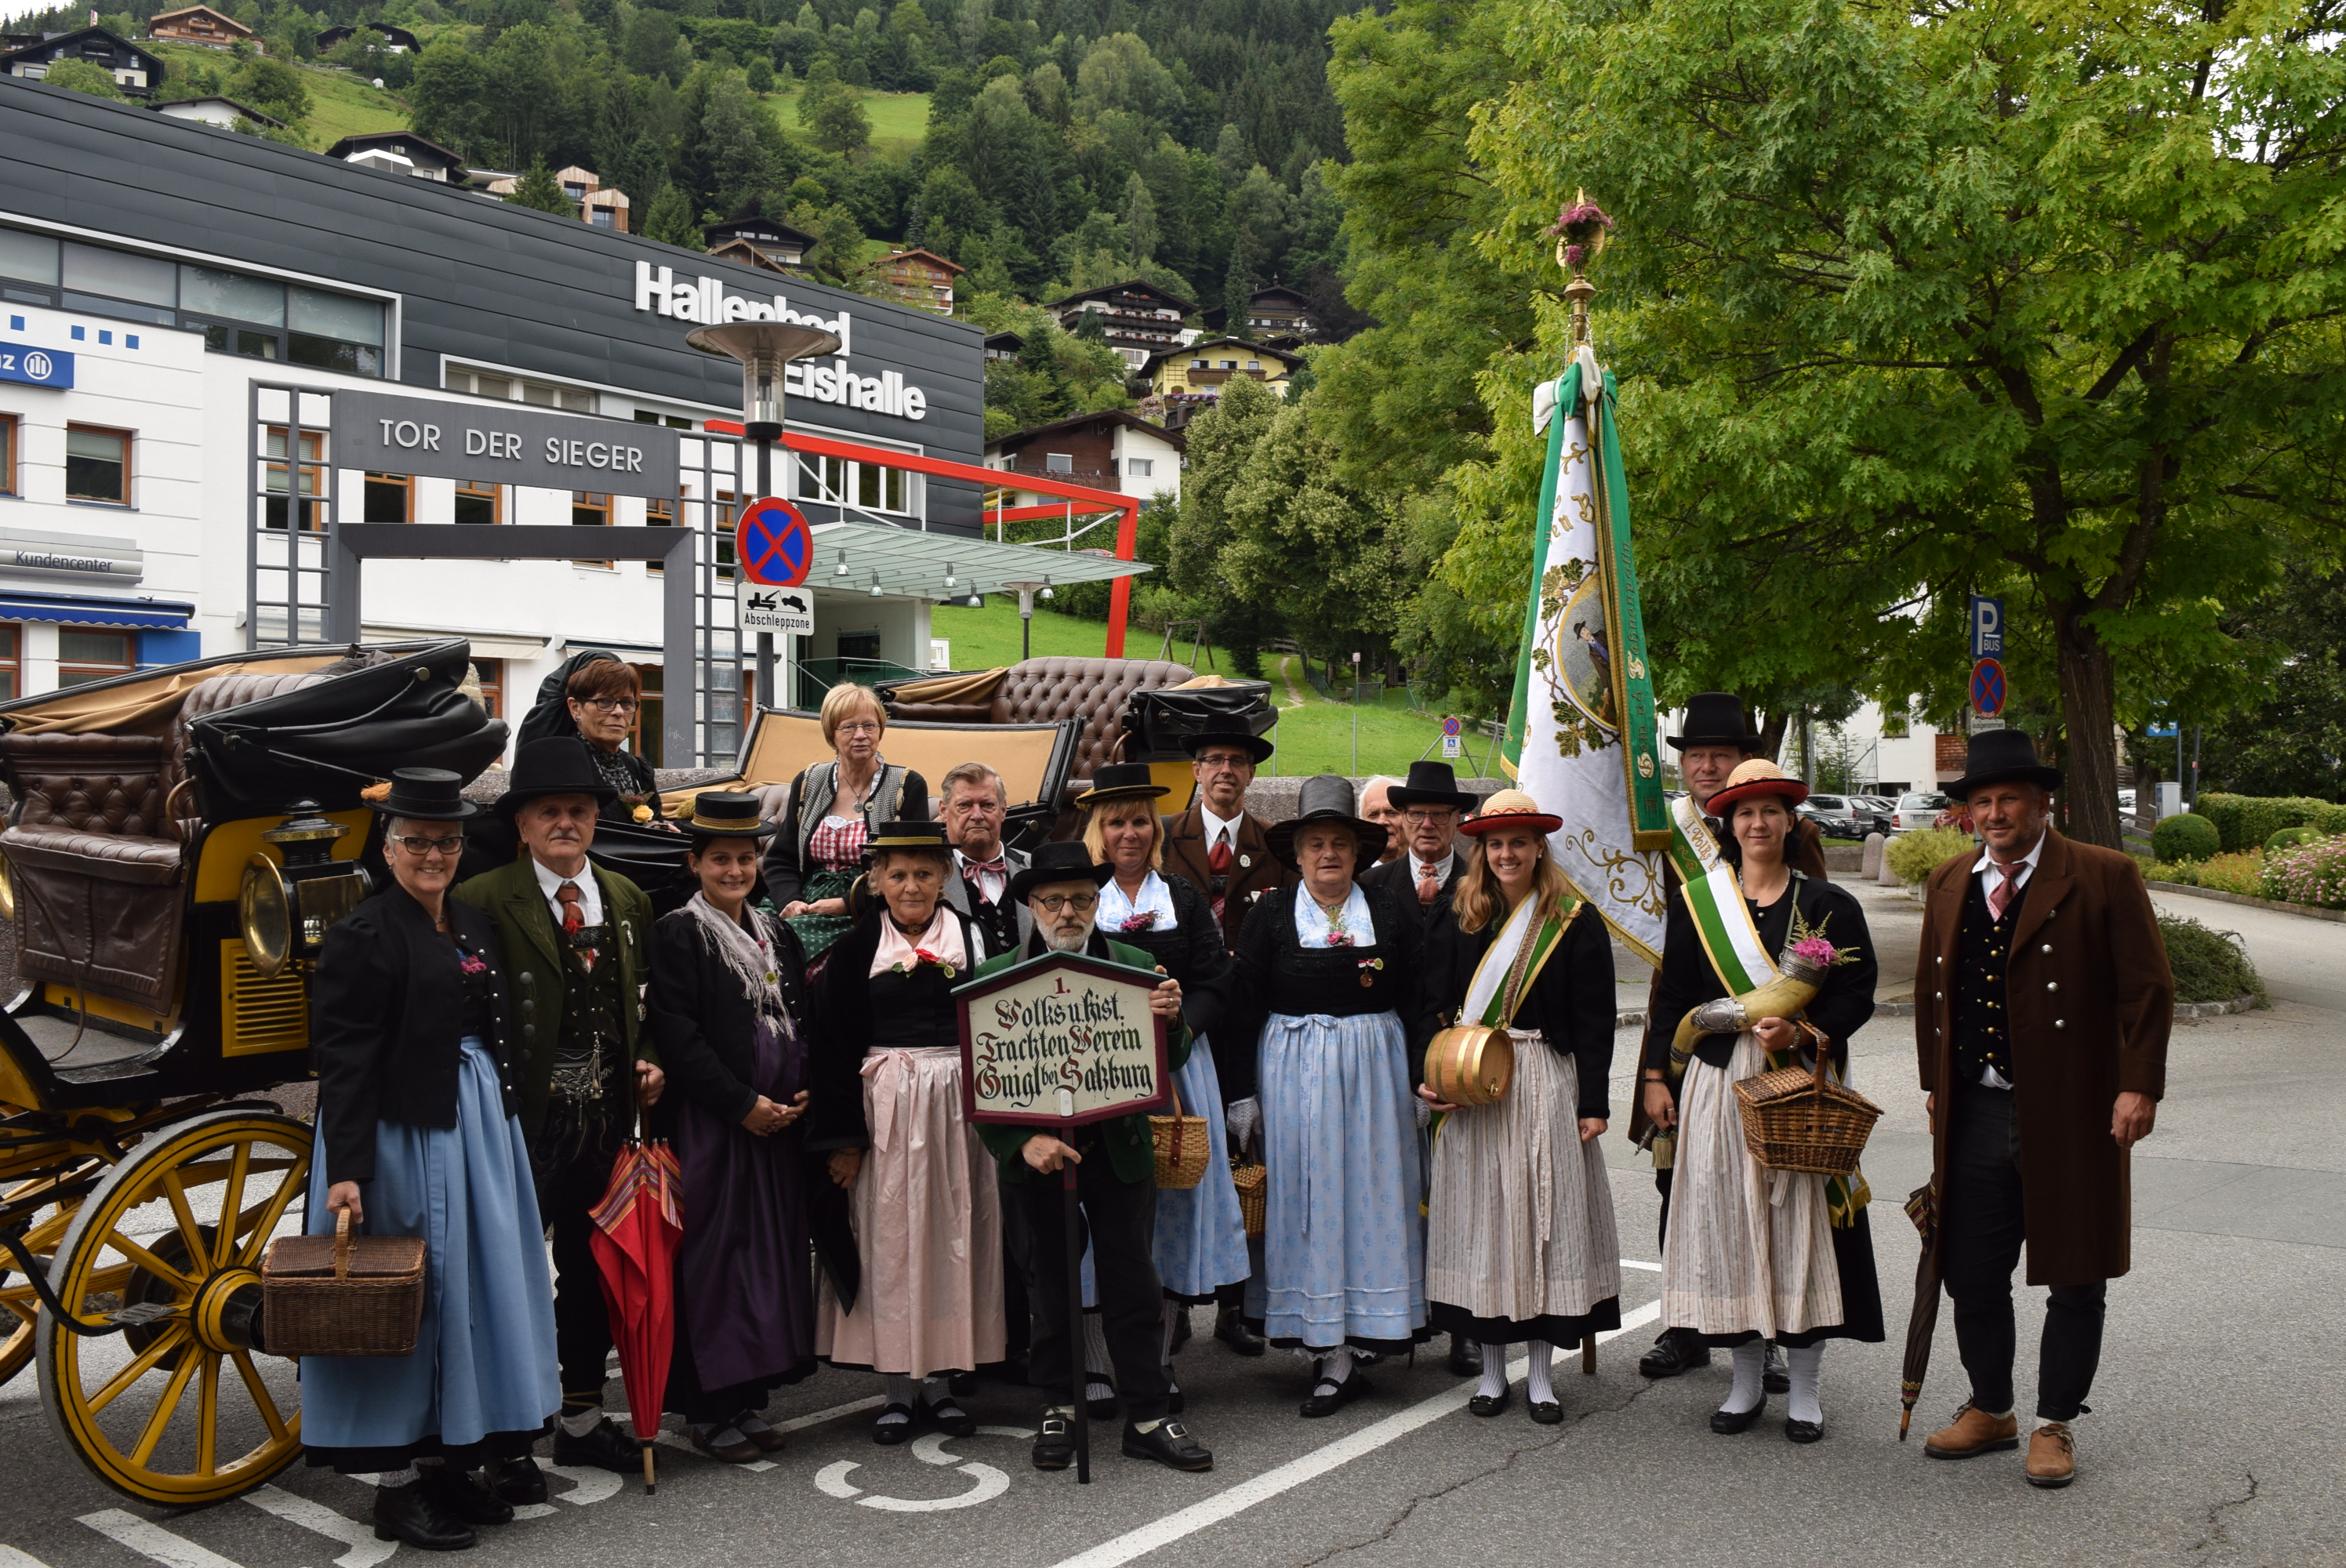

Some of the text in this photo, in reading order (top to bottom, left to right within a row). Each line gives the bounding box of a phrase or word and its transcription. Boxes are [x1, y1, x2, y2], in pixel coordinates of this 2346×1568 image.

[380, 419, 643, 473] TOR DER SIEGER
[16, 550, 114, 572] Kundencenter
[744, 612, 810, 630] Abschleppzone
[1977, 601, 1999, 655] P
[1984, 639, 2000, 652] BUS
[1055, 977, 1071, 994] 1.
[995, 995, 1066, 1032] Volks
[1040, 1062, 1059, 1087] bei
[1052, 1054, 1153, 1100] Salzburg
